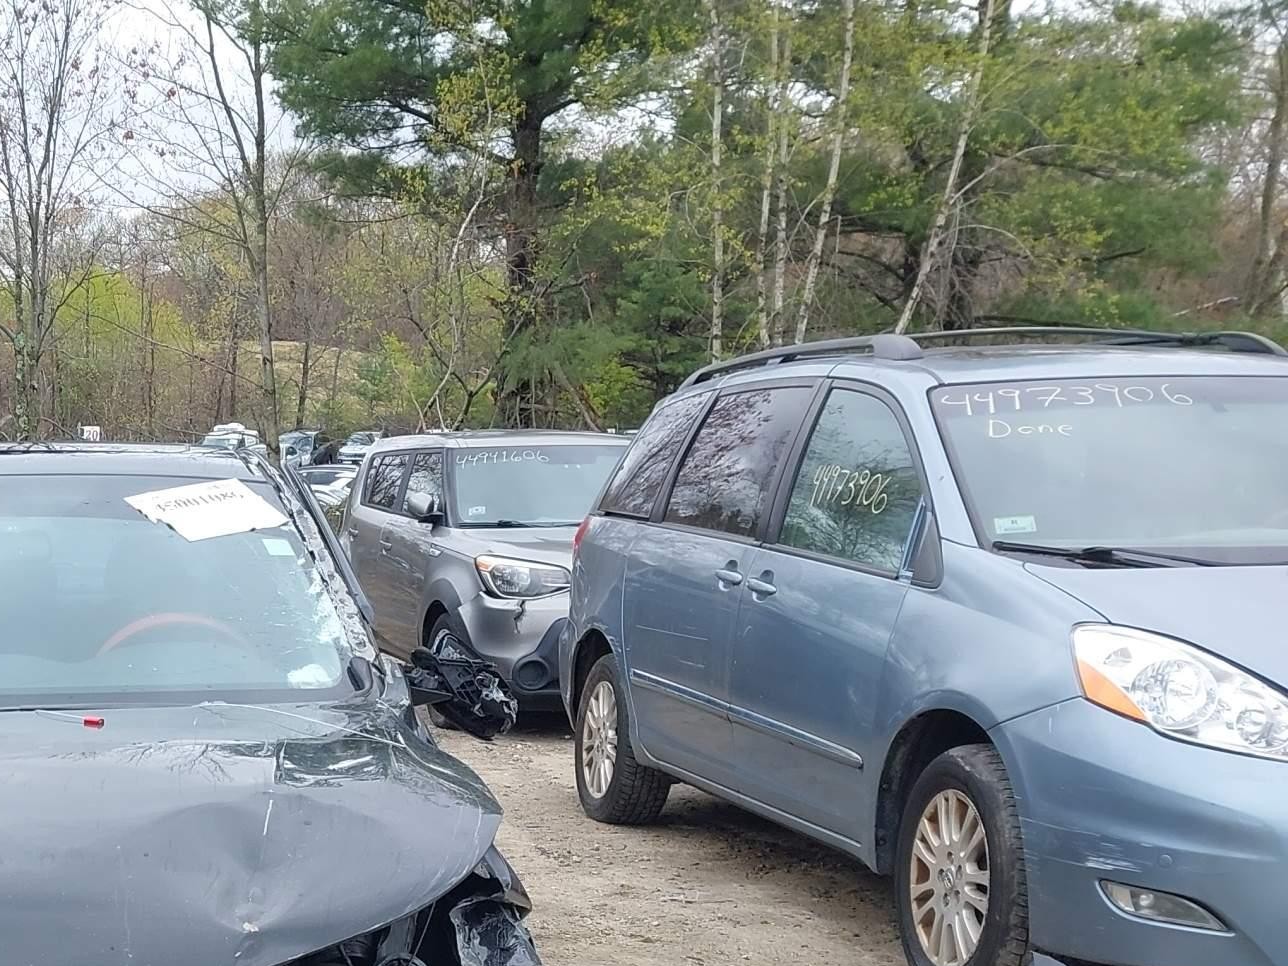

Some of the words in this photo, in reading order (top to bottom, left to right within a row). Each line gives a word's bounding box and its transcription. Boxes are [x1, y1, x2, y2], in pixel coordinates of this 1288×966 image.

[941, 383, 1193, 416] 44973906
[988, 419, 1073, 439] Done
[810, 464, 892, 514] 44973906
